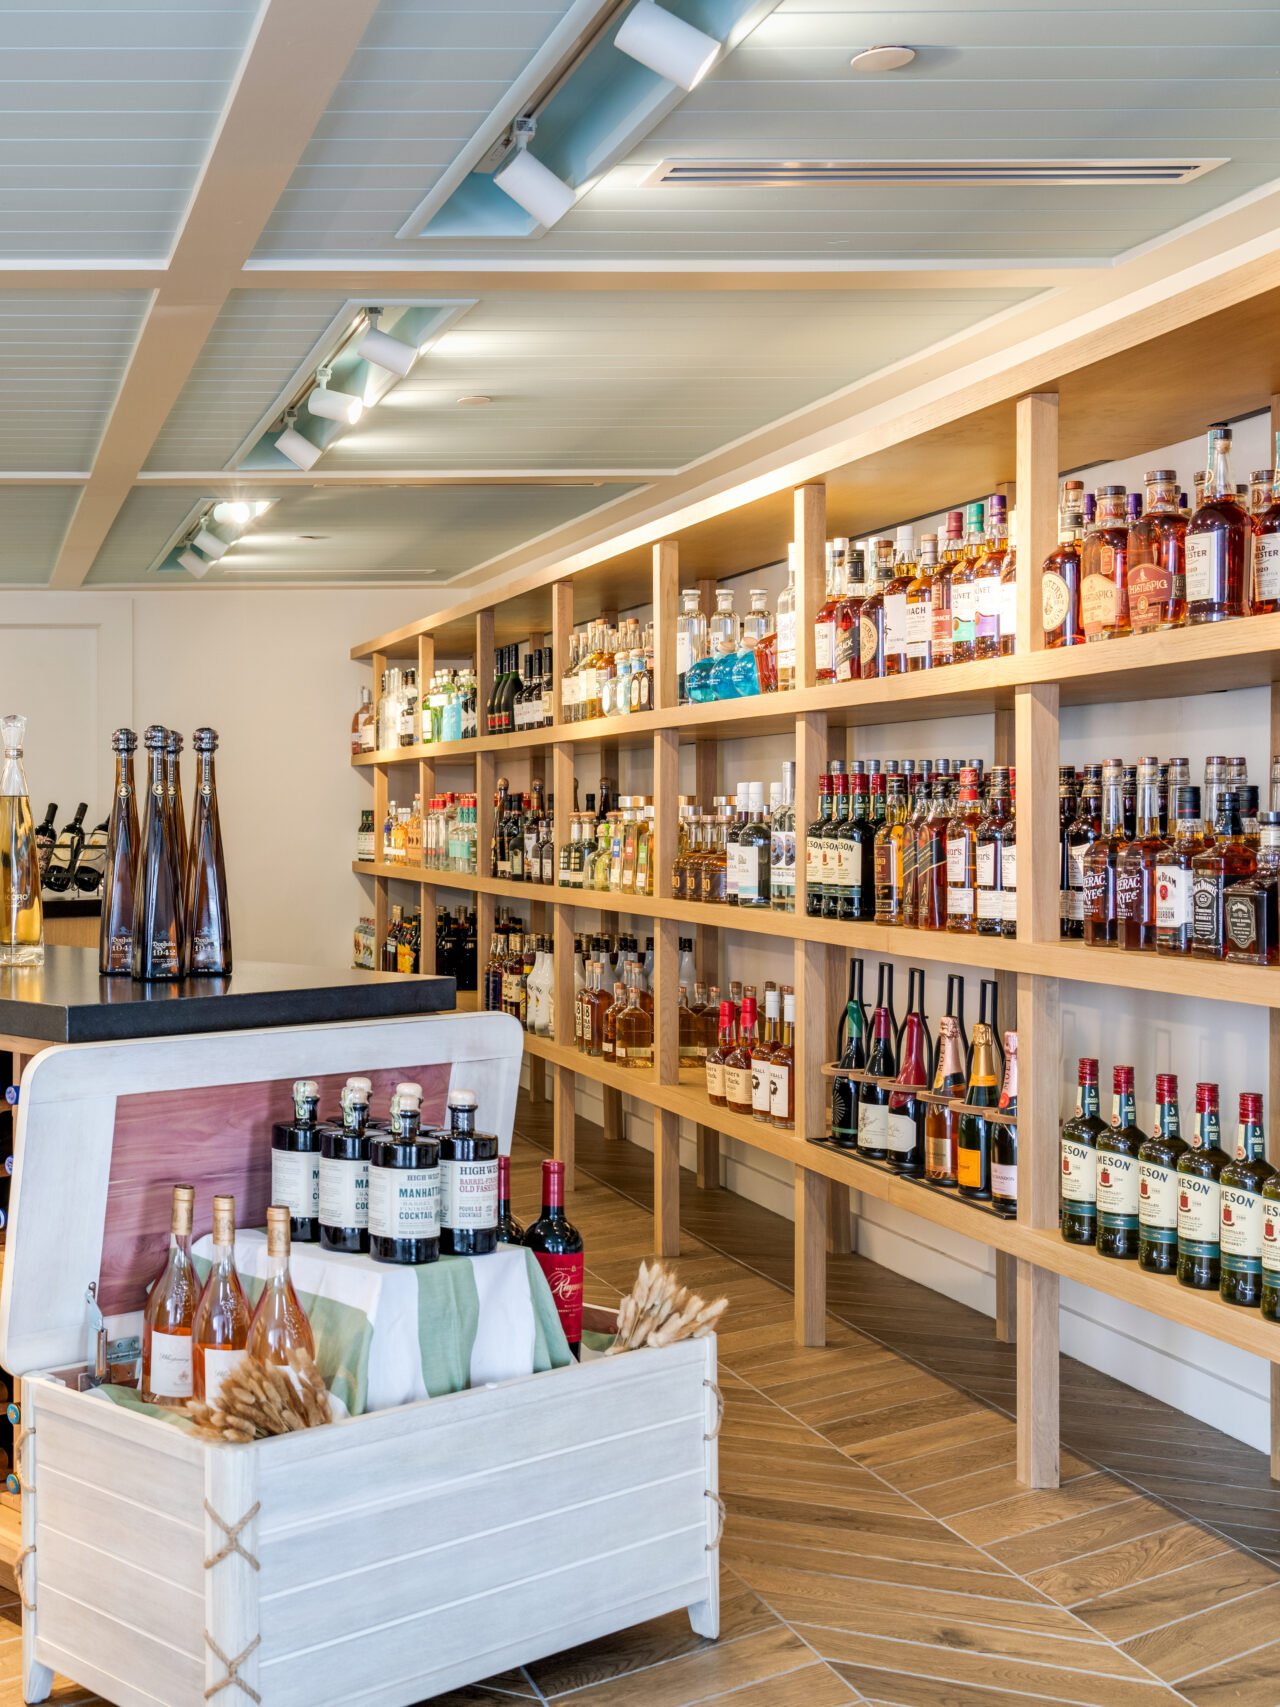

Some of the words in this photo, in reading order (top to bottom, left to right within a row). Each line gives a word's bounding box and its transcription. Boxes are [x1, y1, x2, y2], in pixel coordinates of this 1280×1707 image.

[460, 1166, 486, 1175] HIGH
[460, 1185, 475, 1193] OLD
[399, 1211, 433, 1220] COCKTAIL
